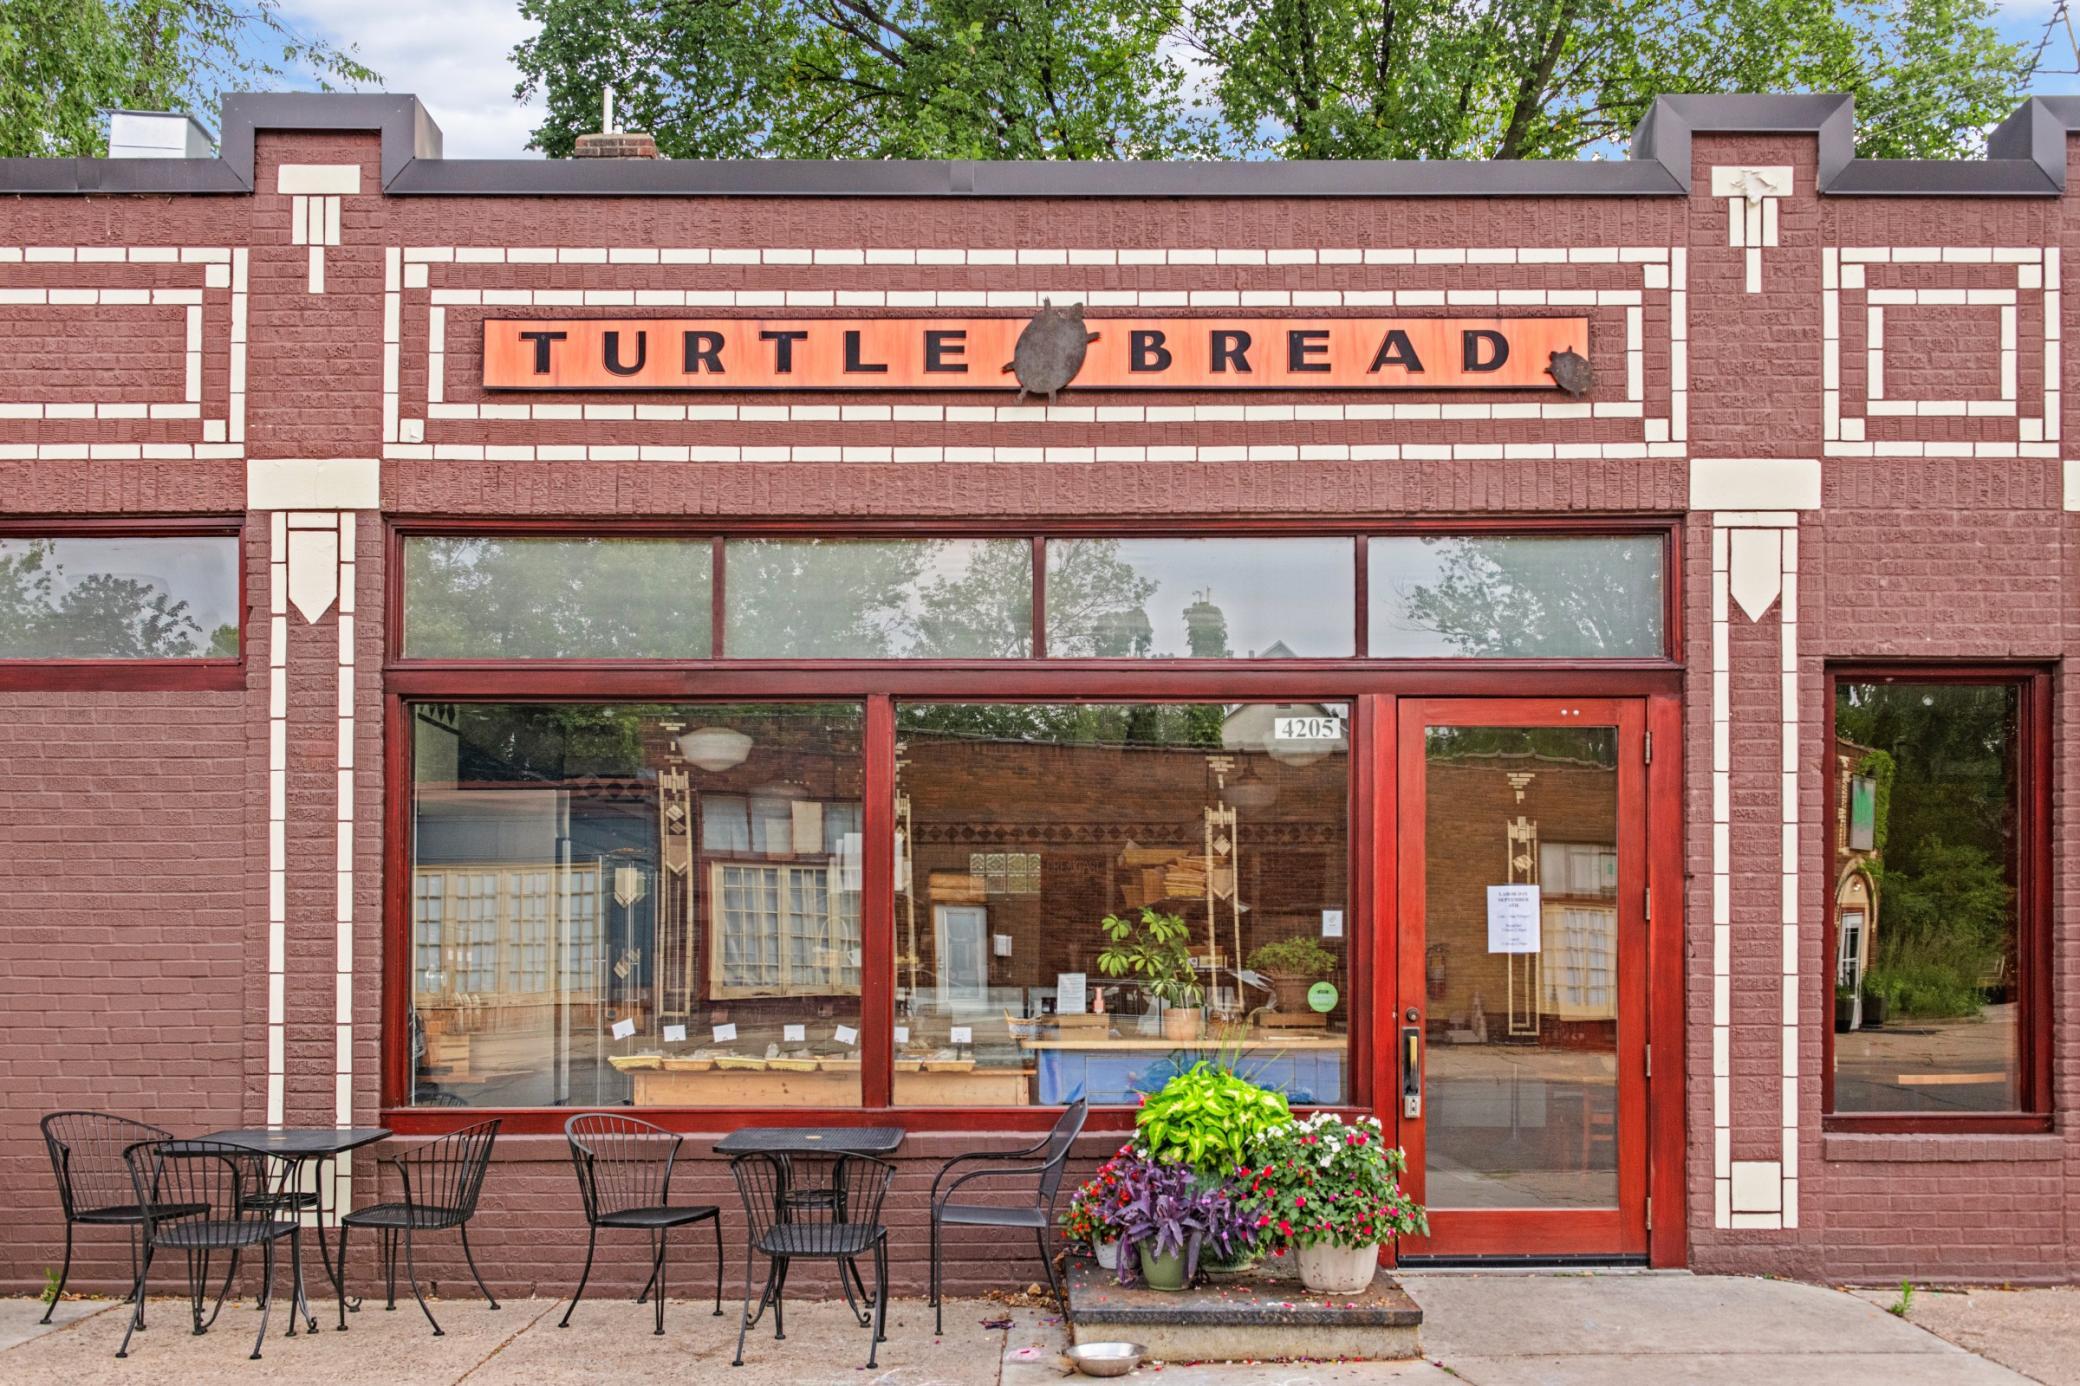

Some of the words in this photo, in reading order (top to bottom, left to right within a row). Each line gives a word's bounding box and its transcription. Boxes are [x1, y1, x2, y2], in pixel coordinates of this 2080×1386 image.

[519, 330, 969, 377] TURTLE
[1127, 329, 1510, 375] BREAD
[1282, 719, 1334, 738] 4205
